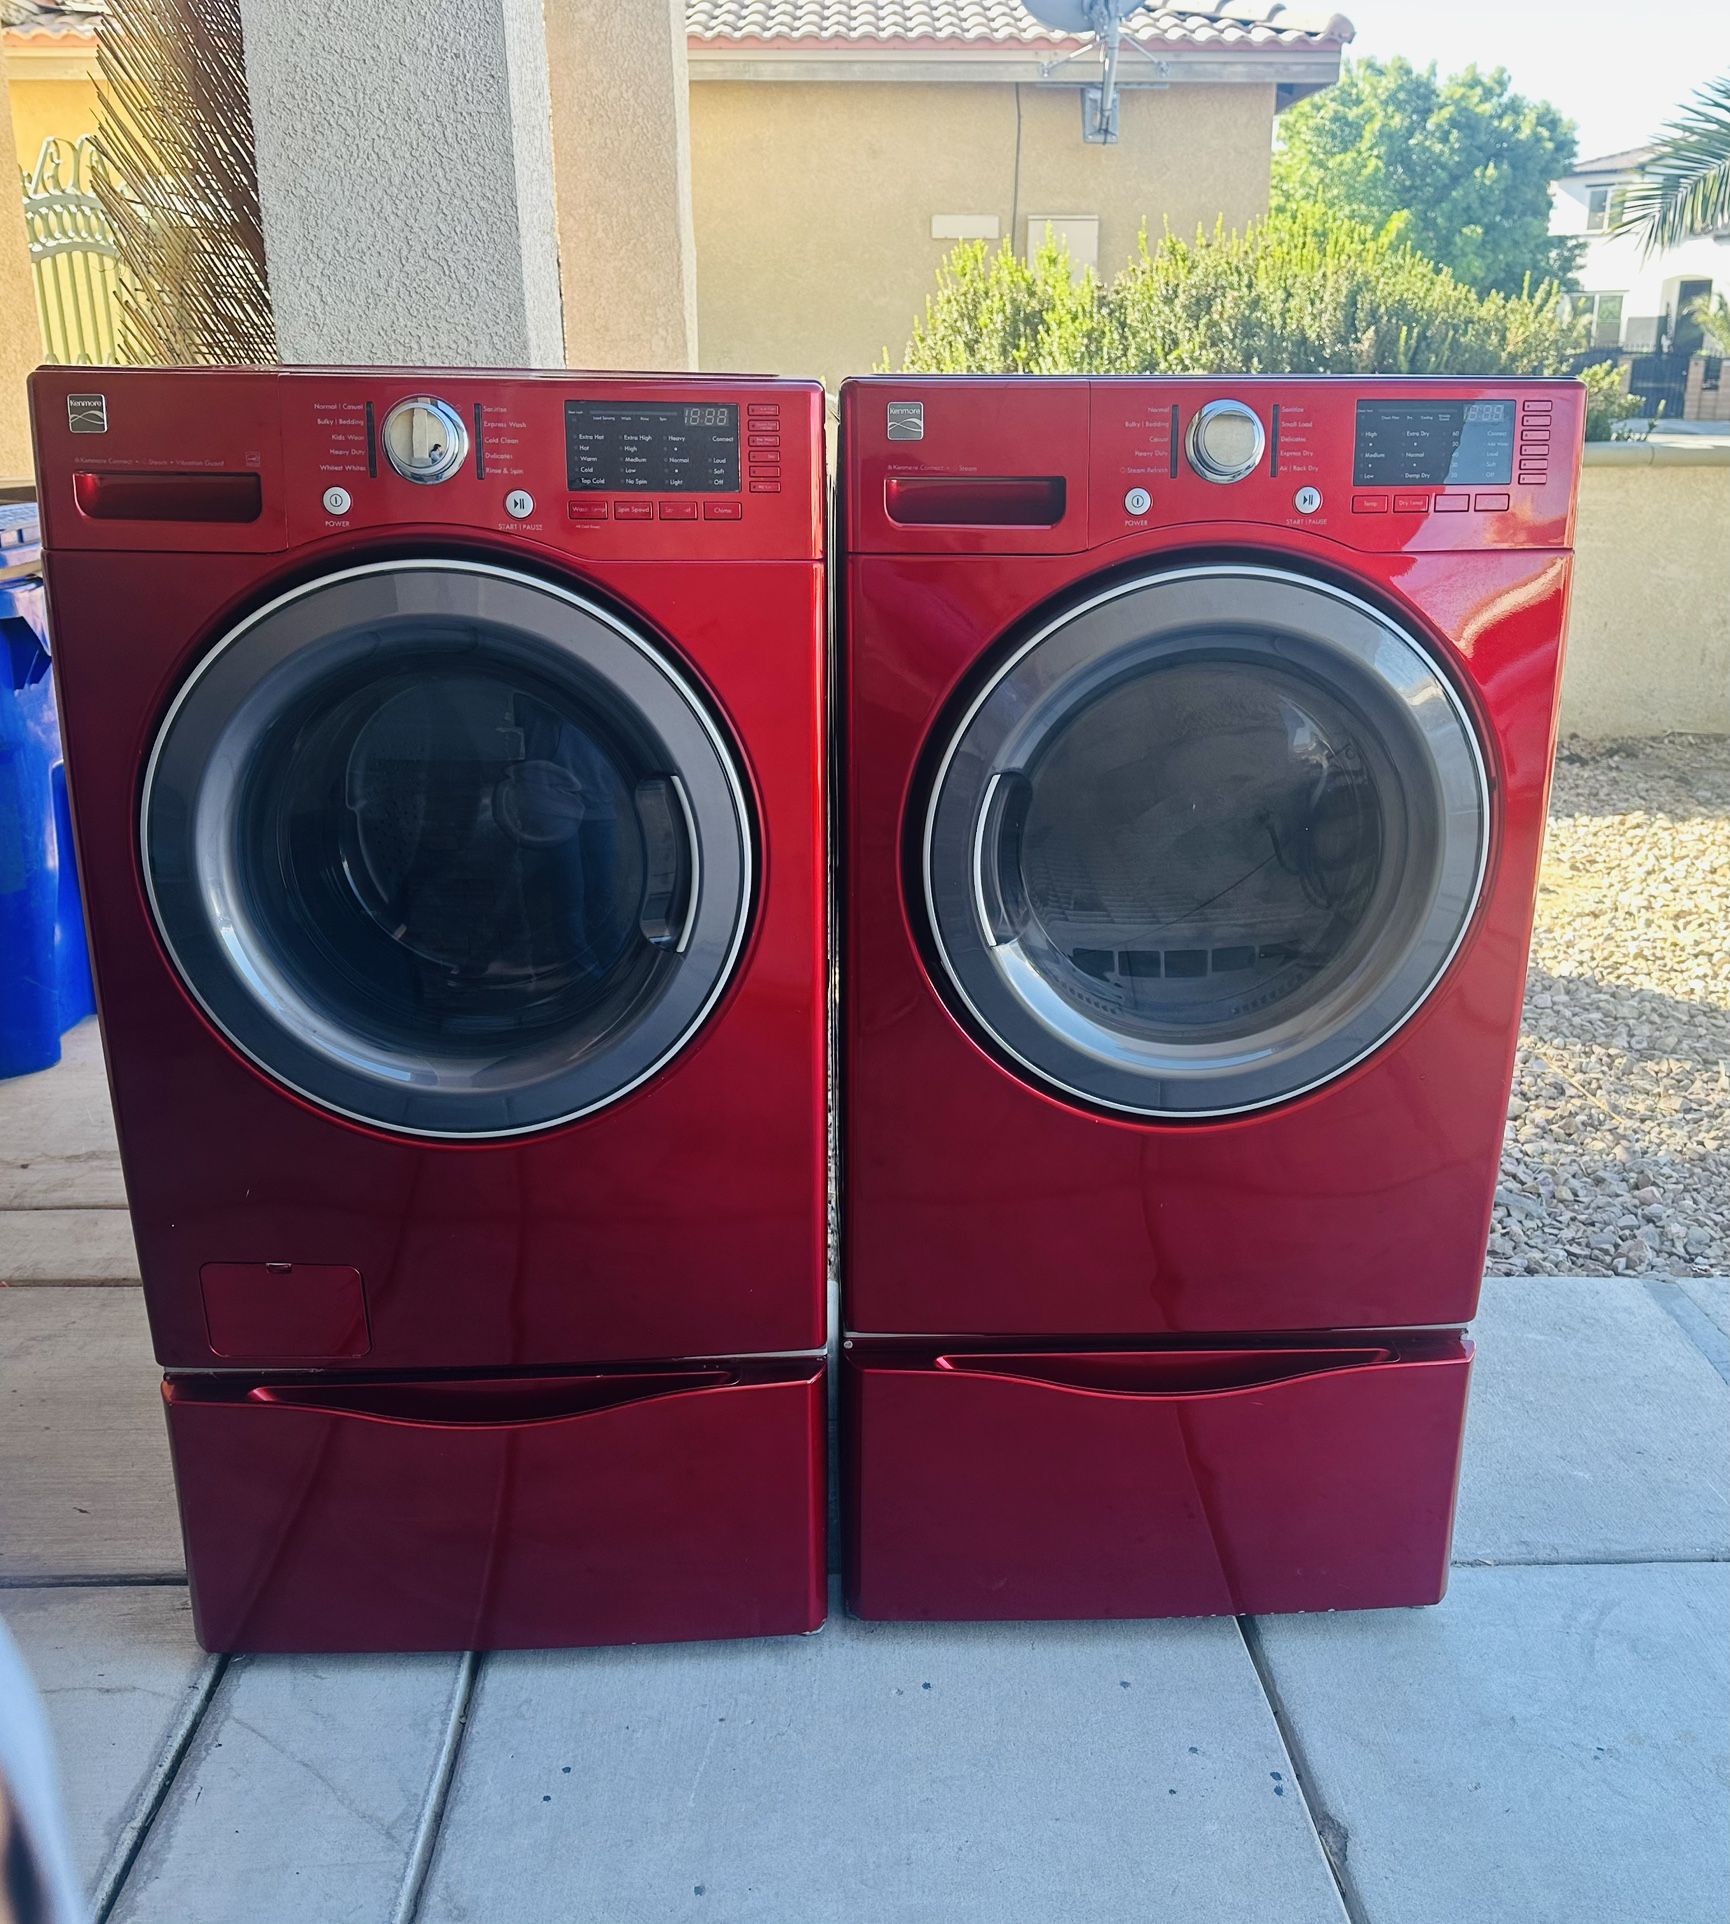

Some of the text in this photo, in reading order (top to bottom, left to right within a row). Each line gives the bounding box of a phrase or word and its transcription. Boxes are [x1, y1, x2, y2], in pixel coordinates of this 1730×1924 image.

[70, 399, 102, 407] Kenmore
[889, 407, 920, 415] Kenmore
[317, 418, 364, 426] Bulky Bedding
[483, 421, 507, 429] Express
[1146, 421, 1169, 429] Bedding
